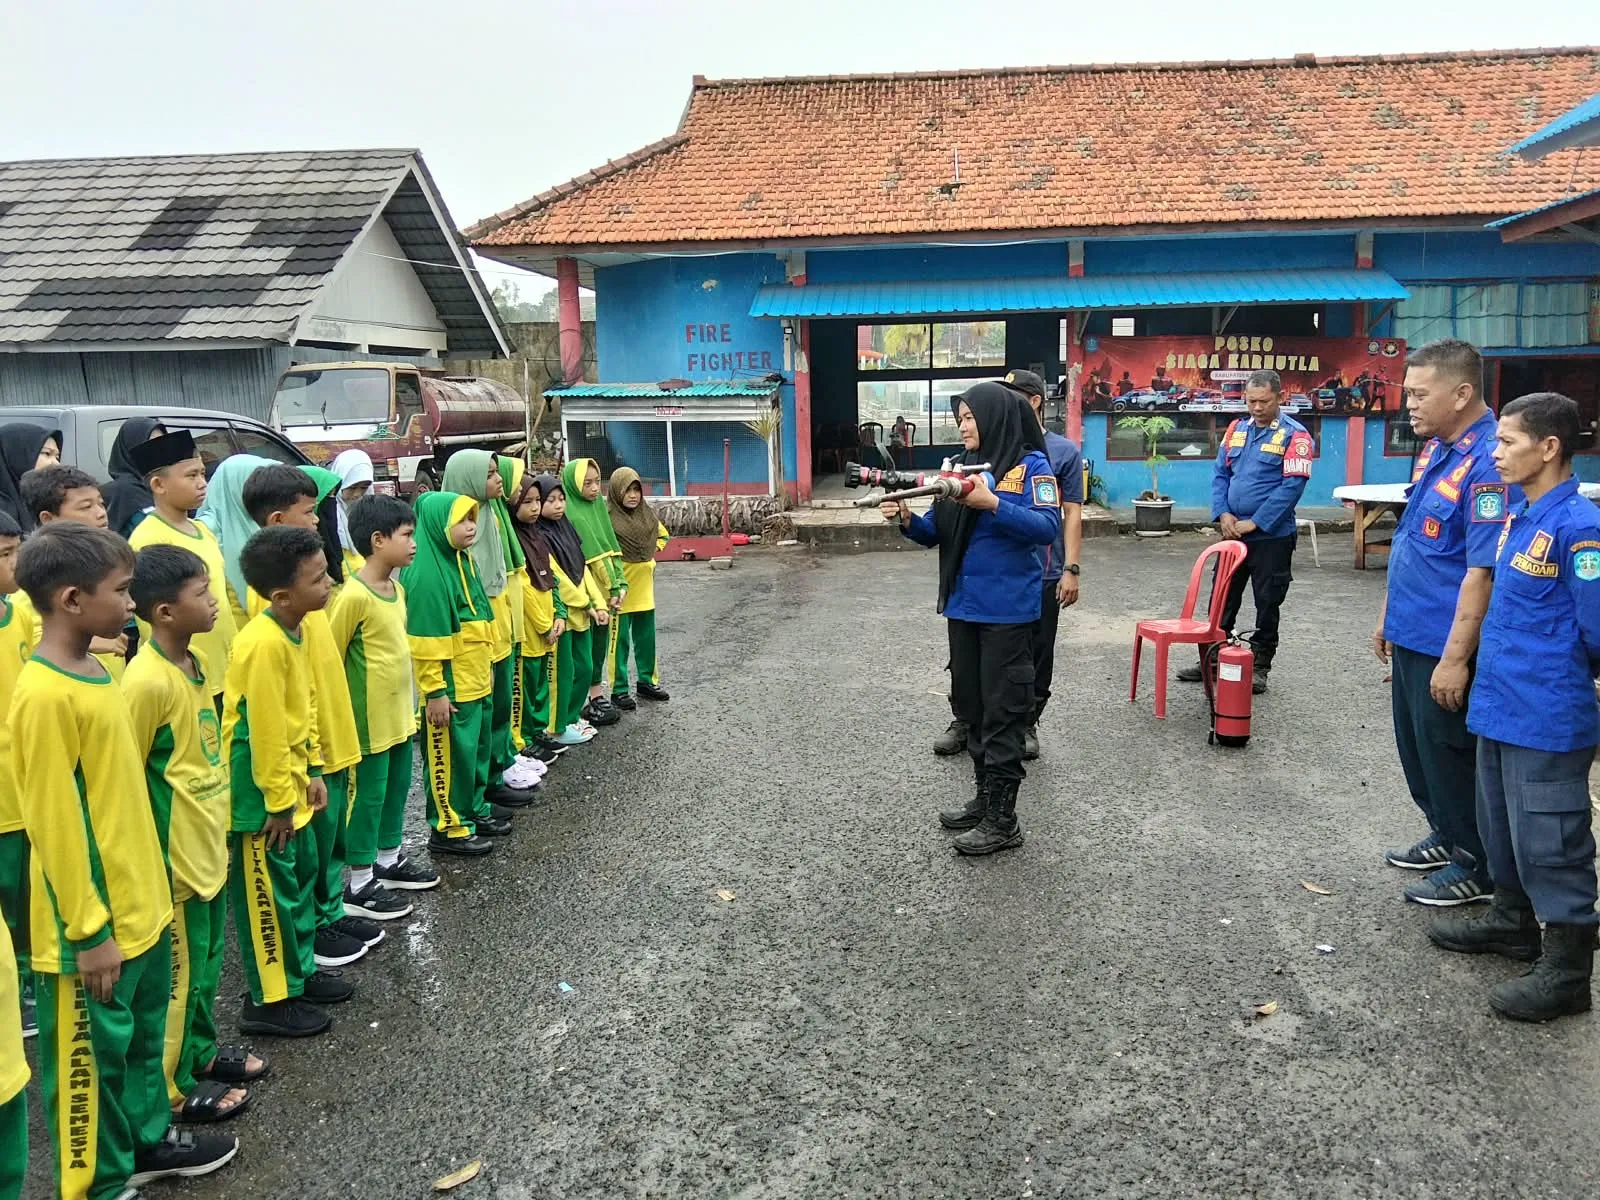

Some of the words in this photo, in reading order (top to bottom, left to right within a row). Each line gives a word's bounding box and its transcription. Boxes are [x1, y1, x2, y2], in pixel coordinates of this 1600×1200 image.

[686, 323, 732, 343] FIRE
[1214, 336, 1273, 352] POSKO
[688, 351, 771, 372] FIGHTER
[1165, 353, 1220, 369] SIAGA
[1513, 555, 1555, 576] PEMADAM
[251, 834, 263, 875] ELITA
[260, 910, 278, 965] SEMESTA
[70, 1046, 92, 1090] ALAM
[69, 1093, 90, 1169] SEMESTA
